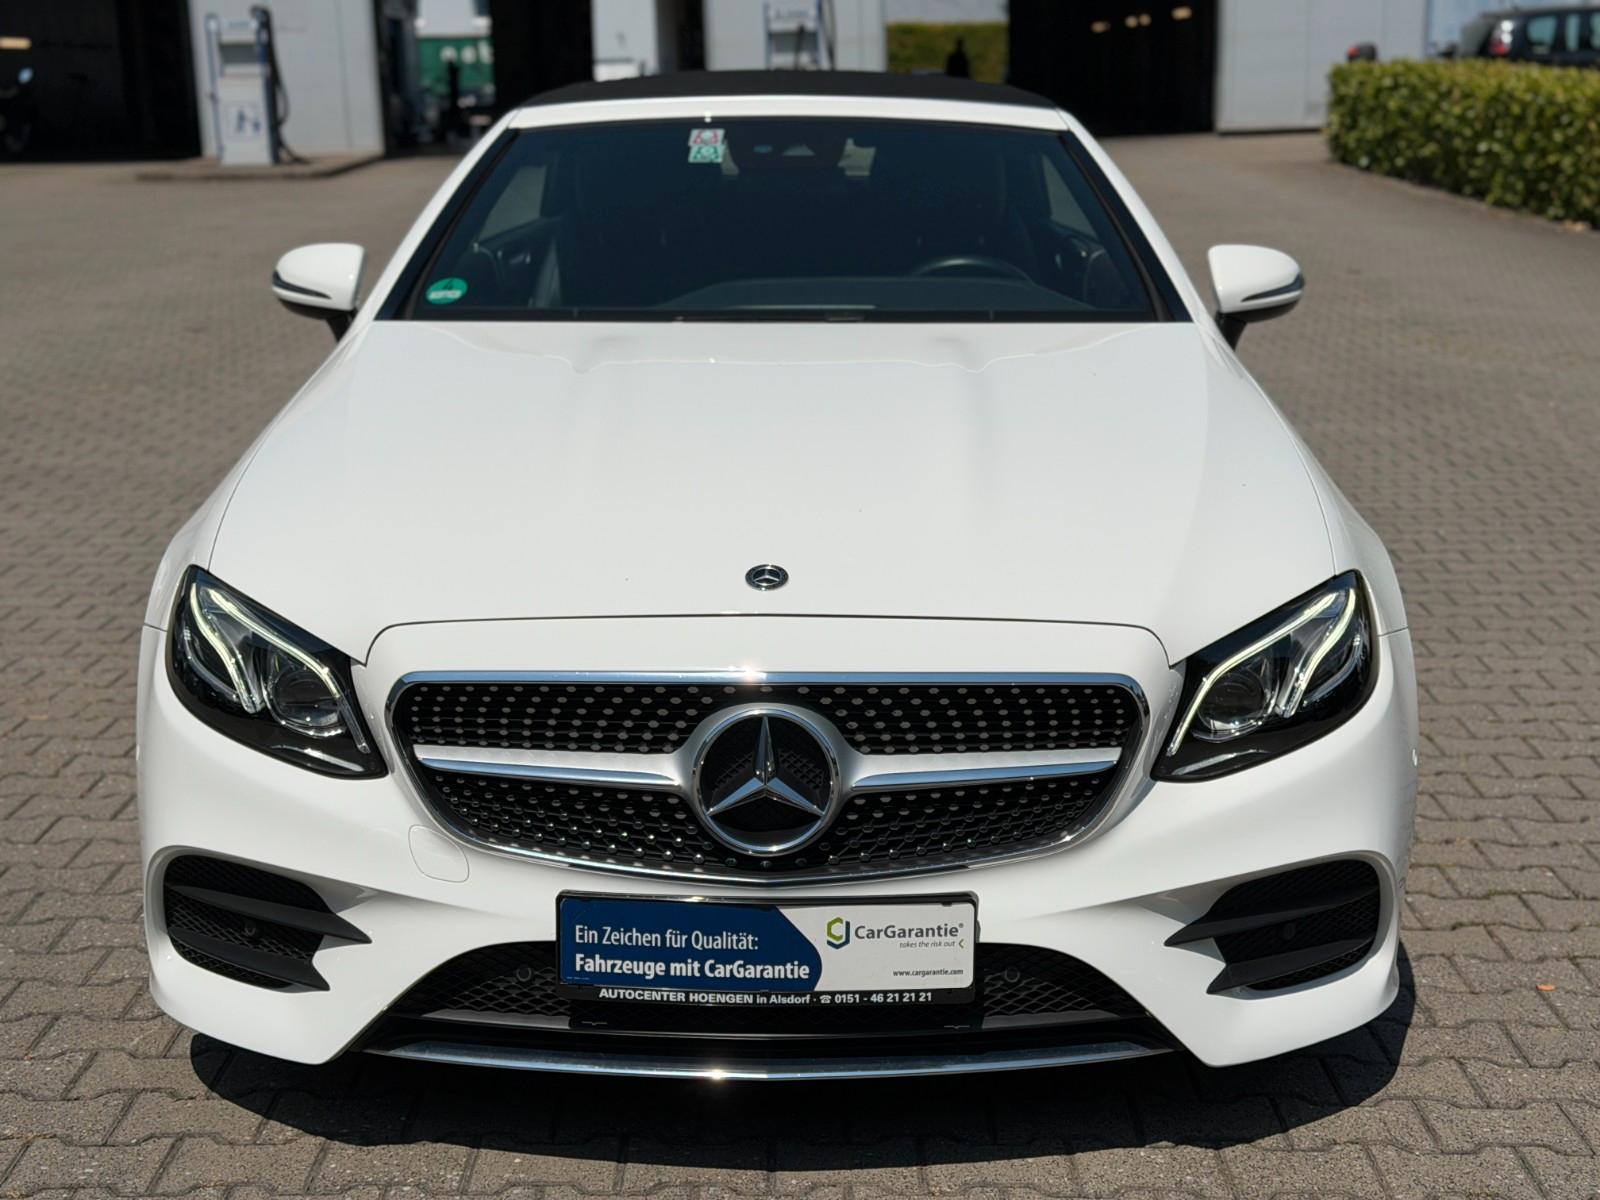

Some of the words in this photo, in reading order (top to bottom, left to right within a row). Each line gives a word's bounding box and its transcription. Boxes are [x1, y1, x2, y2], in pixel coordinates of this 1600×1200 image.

[575, 924, 598, 944] Ein
[602, 926, 661, 947] Zeichen
[665, 929, 687, 948] für
[691, 930, 759, 950] Qualität:
[575, 953, 666, 979] Fahrzeuge
[670, 957, 700, 976] mit
[704, 959, 810, 980] CarGarantie
[893, 968, 964, 977] www.cargarantie.com
[599, 988, 686, 1001] AUTOCENTER
[689, 992, 754, 1004] HOENGEN
[756, 994, 768, 1004] in
[769, 994, 811, 1005] Alsdorf
[834, 993, 860, 1004] 0151
[870, 992, 885, 1002] 46
[886, 992, 900, 1002] 21
[902, 992, 916, 1002] 21
[918, 992, 933, 1002] 21
